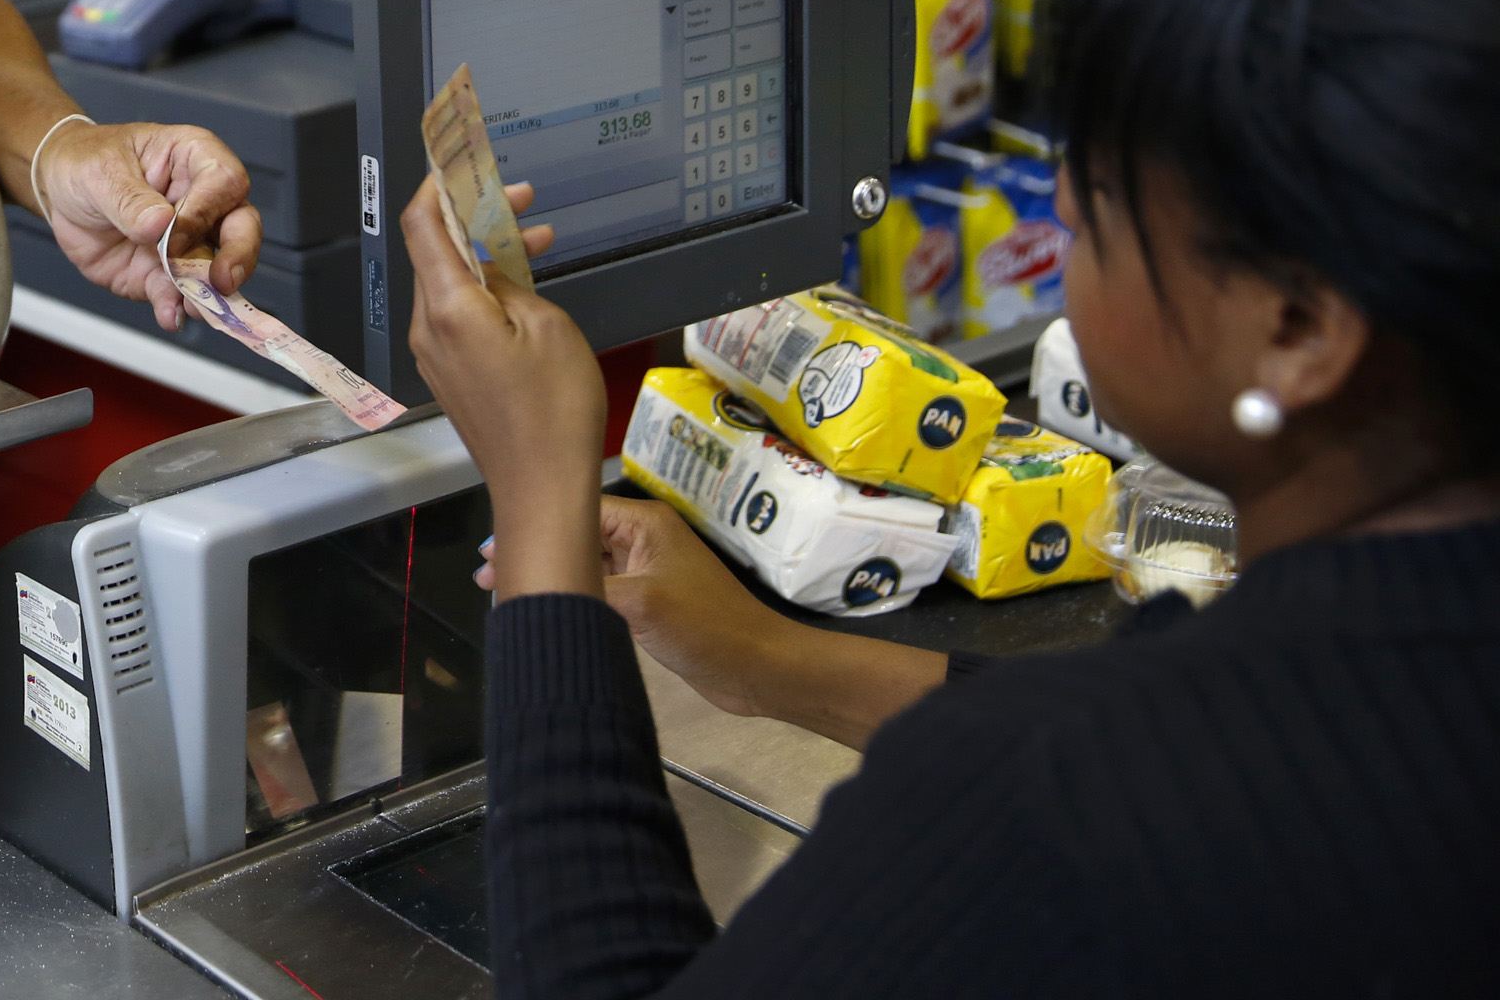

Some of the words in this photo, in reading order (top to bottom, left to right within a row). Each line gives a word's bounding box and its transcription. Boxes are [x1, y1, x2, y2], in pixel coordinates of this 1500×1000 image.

[692, 95, 699, 110] 7
[717, 89, 725, 103] 8
[743, 84, 751, 97] 9
[599, 110, 652, 138] 313.68
[691, 132, 699, 145] 4
[718, 126, 725, 138] 5
[743, 119, 751, 132] 6
[693, 167, 699, 180] 1
[718, 160, 726, 173] 2
[744, 153, 751, 166] 3
[718, 194, 726, 208] 0
[743, 182, 775, 200] Enter
[335, 366, 366, 390] 20
[922, 407, 963, 438] PAN
[1028, 537, 1067, 562] PAN
[848, 569, 896, 598] PAN
[52, 694, 77, 720] 2013
